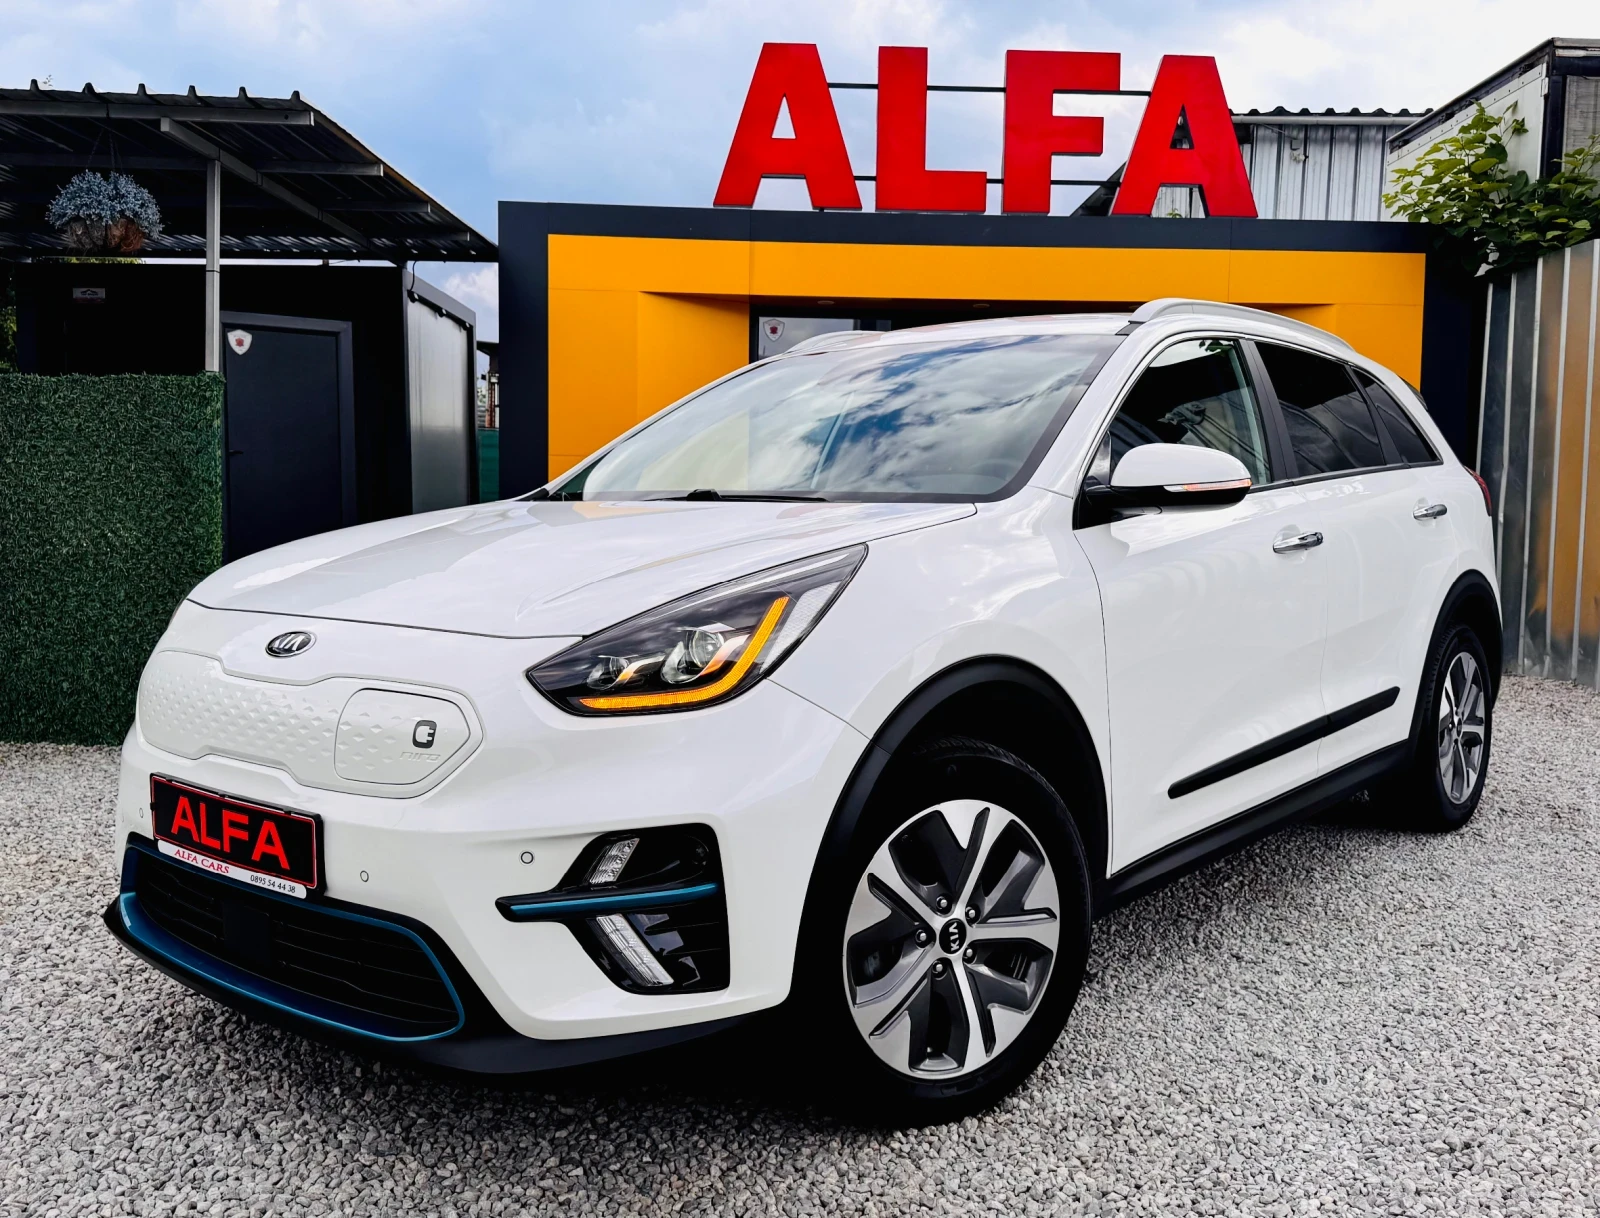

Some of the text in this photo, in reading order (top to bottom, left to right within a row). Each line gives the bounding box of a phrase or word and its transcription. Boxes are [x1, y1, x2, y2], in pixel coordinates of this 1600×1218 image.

[712, 42, 1258, 218] ALFA
[171, 796, 290, 870] ALFA
[174, 849, 230, 874] ALFA CARS
[250, 875, 296, 894] 0895 54 44 38
[949, 922, 960, 952] KIA
